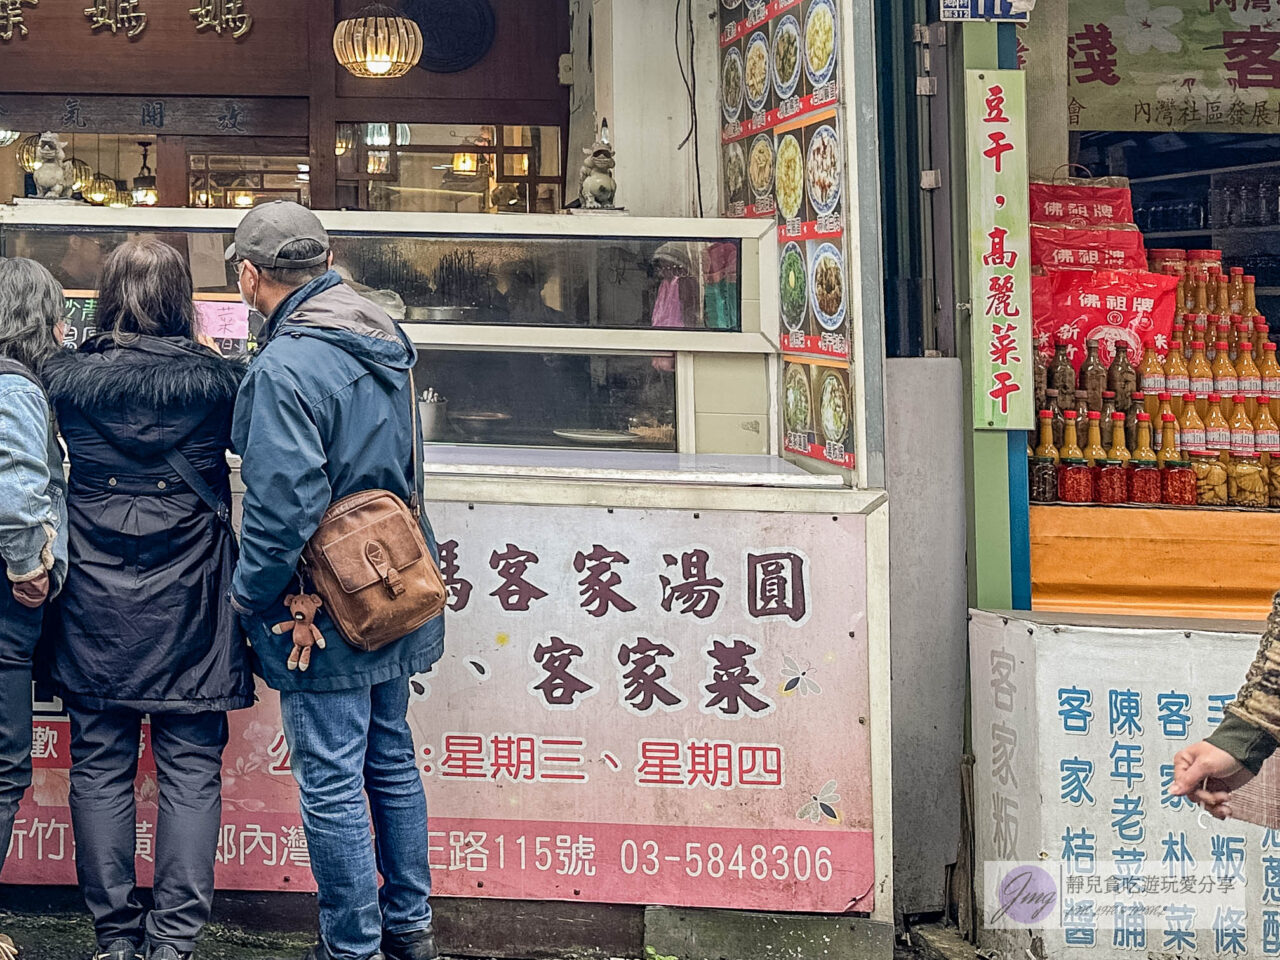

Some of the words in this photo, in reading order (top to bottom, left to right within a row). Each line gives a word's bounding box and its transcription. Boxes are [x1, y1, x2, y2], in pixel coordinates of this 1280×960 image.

[1043, 201, 1114, 218] 佛祖牌
[1078, 293, 1155, 312] 佛祖牌
[1207, 693, 1247, 954] 手粄條
[621, 839, 833, 883] 03-5848306
